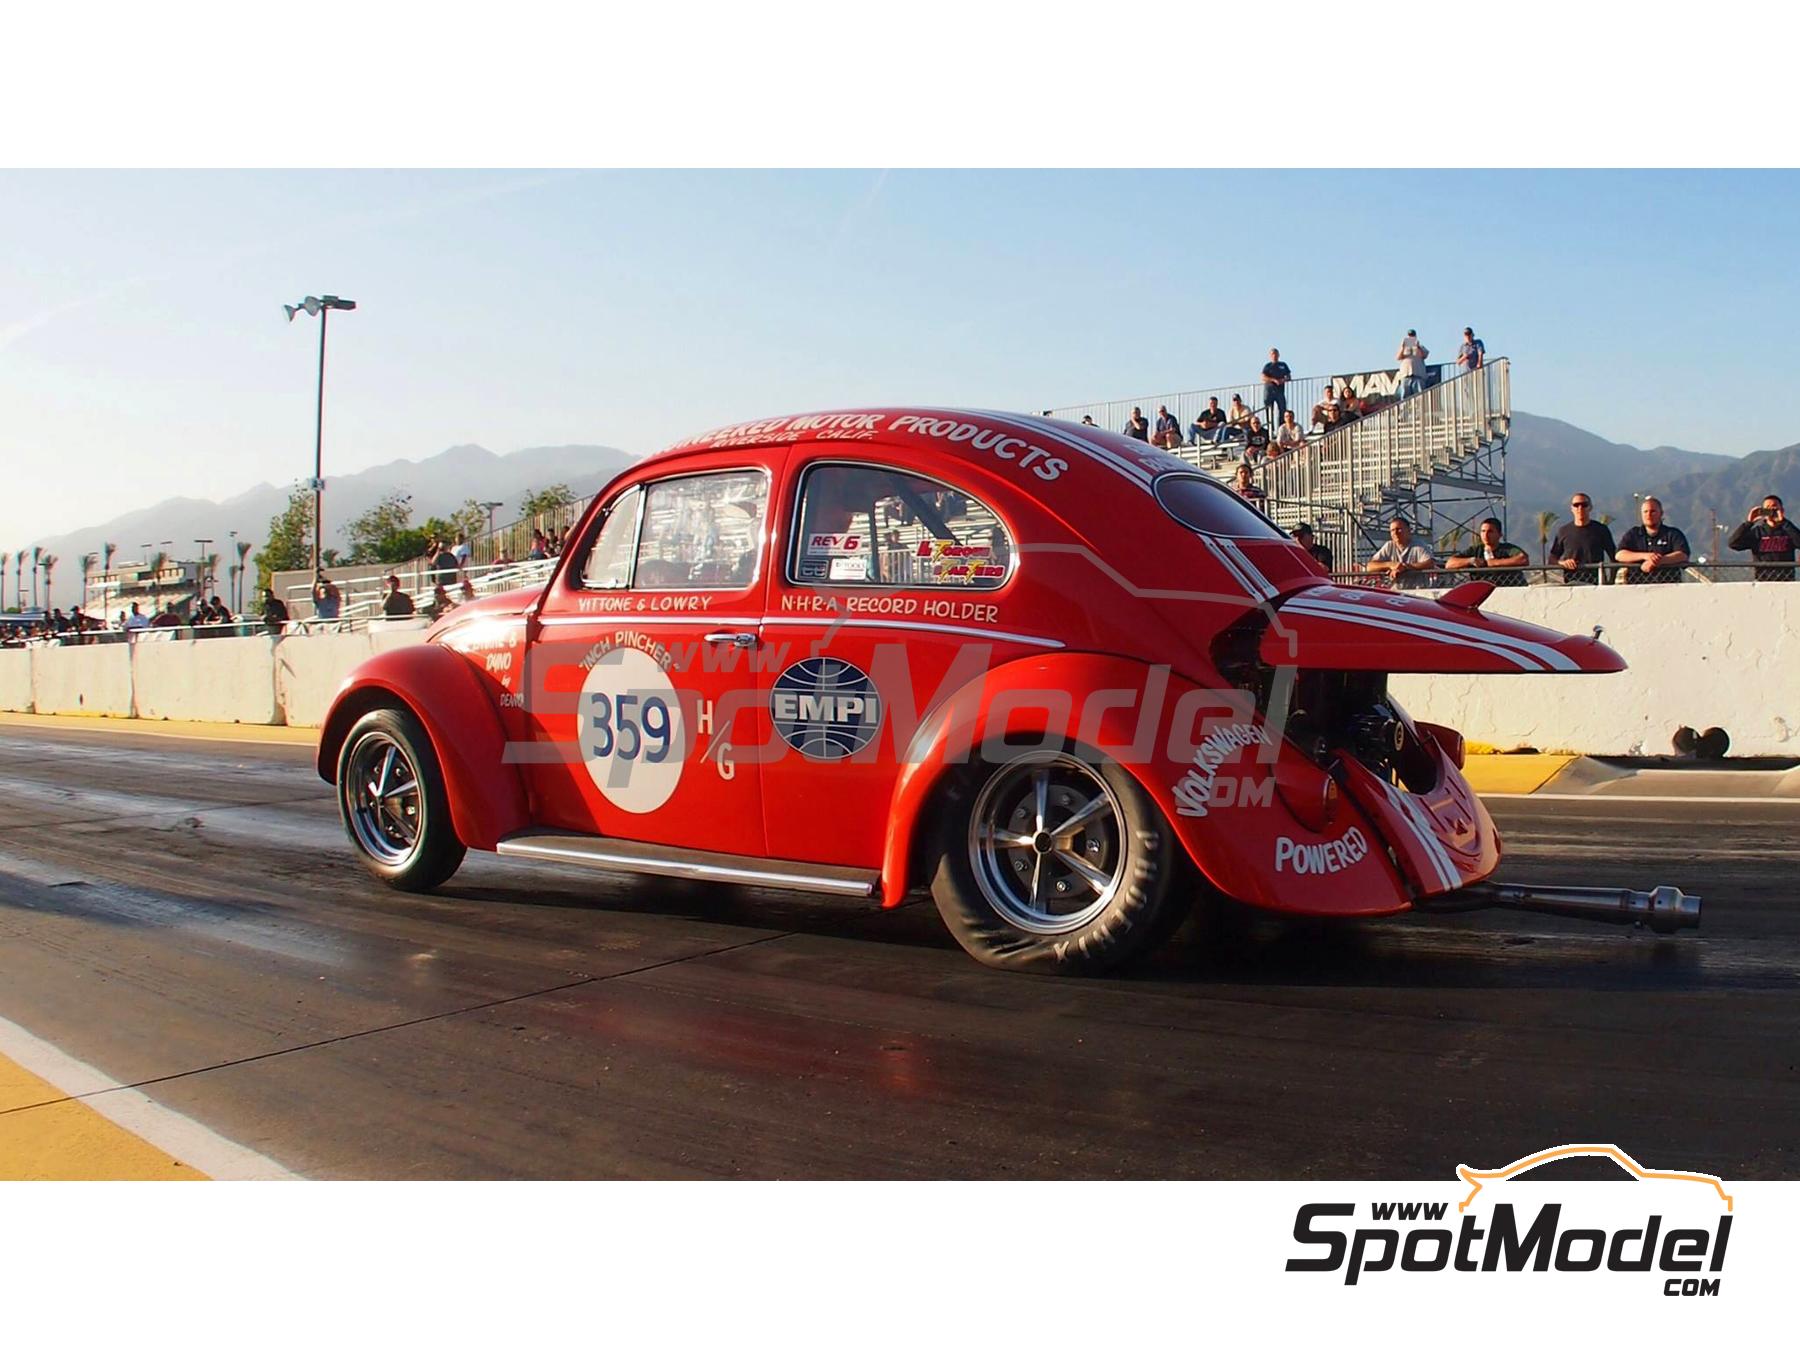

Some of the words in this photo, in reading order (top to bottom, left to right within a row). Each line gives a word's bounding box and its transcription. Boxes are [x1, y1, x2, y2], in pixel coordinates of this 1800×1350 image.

[709, 430, 806, 448] RIVERSIDE
[785, 414, 886, 431] MOTOR
[889, 414, 1070, 481] PRODUCTS
[811, 535, 845, 547] REV
[843, 535, 862, 551] 6
[578, 597, 633, 612] VITTONE
[636, 599, 646, 611] &
[650, 595, 713, 611] LOWRY
[846, 597, 918, 615] RECORD
[922, 600, 998, 624] HOLDER
[773, 694, 879, 724] EMPI
[590, 692, 671, 764] 359
[1171, 723, 1273, 817] VOLKSWAGEN
[1274, 826, 1368, 875] POWERED
